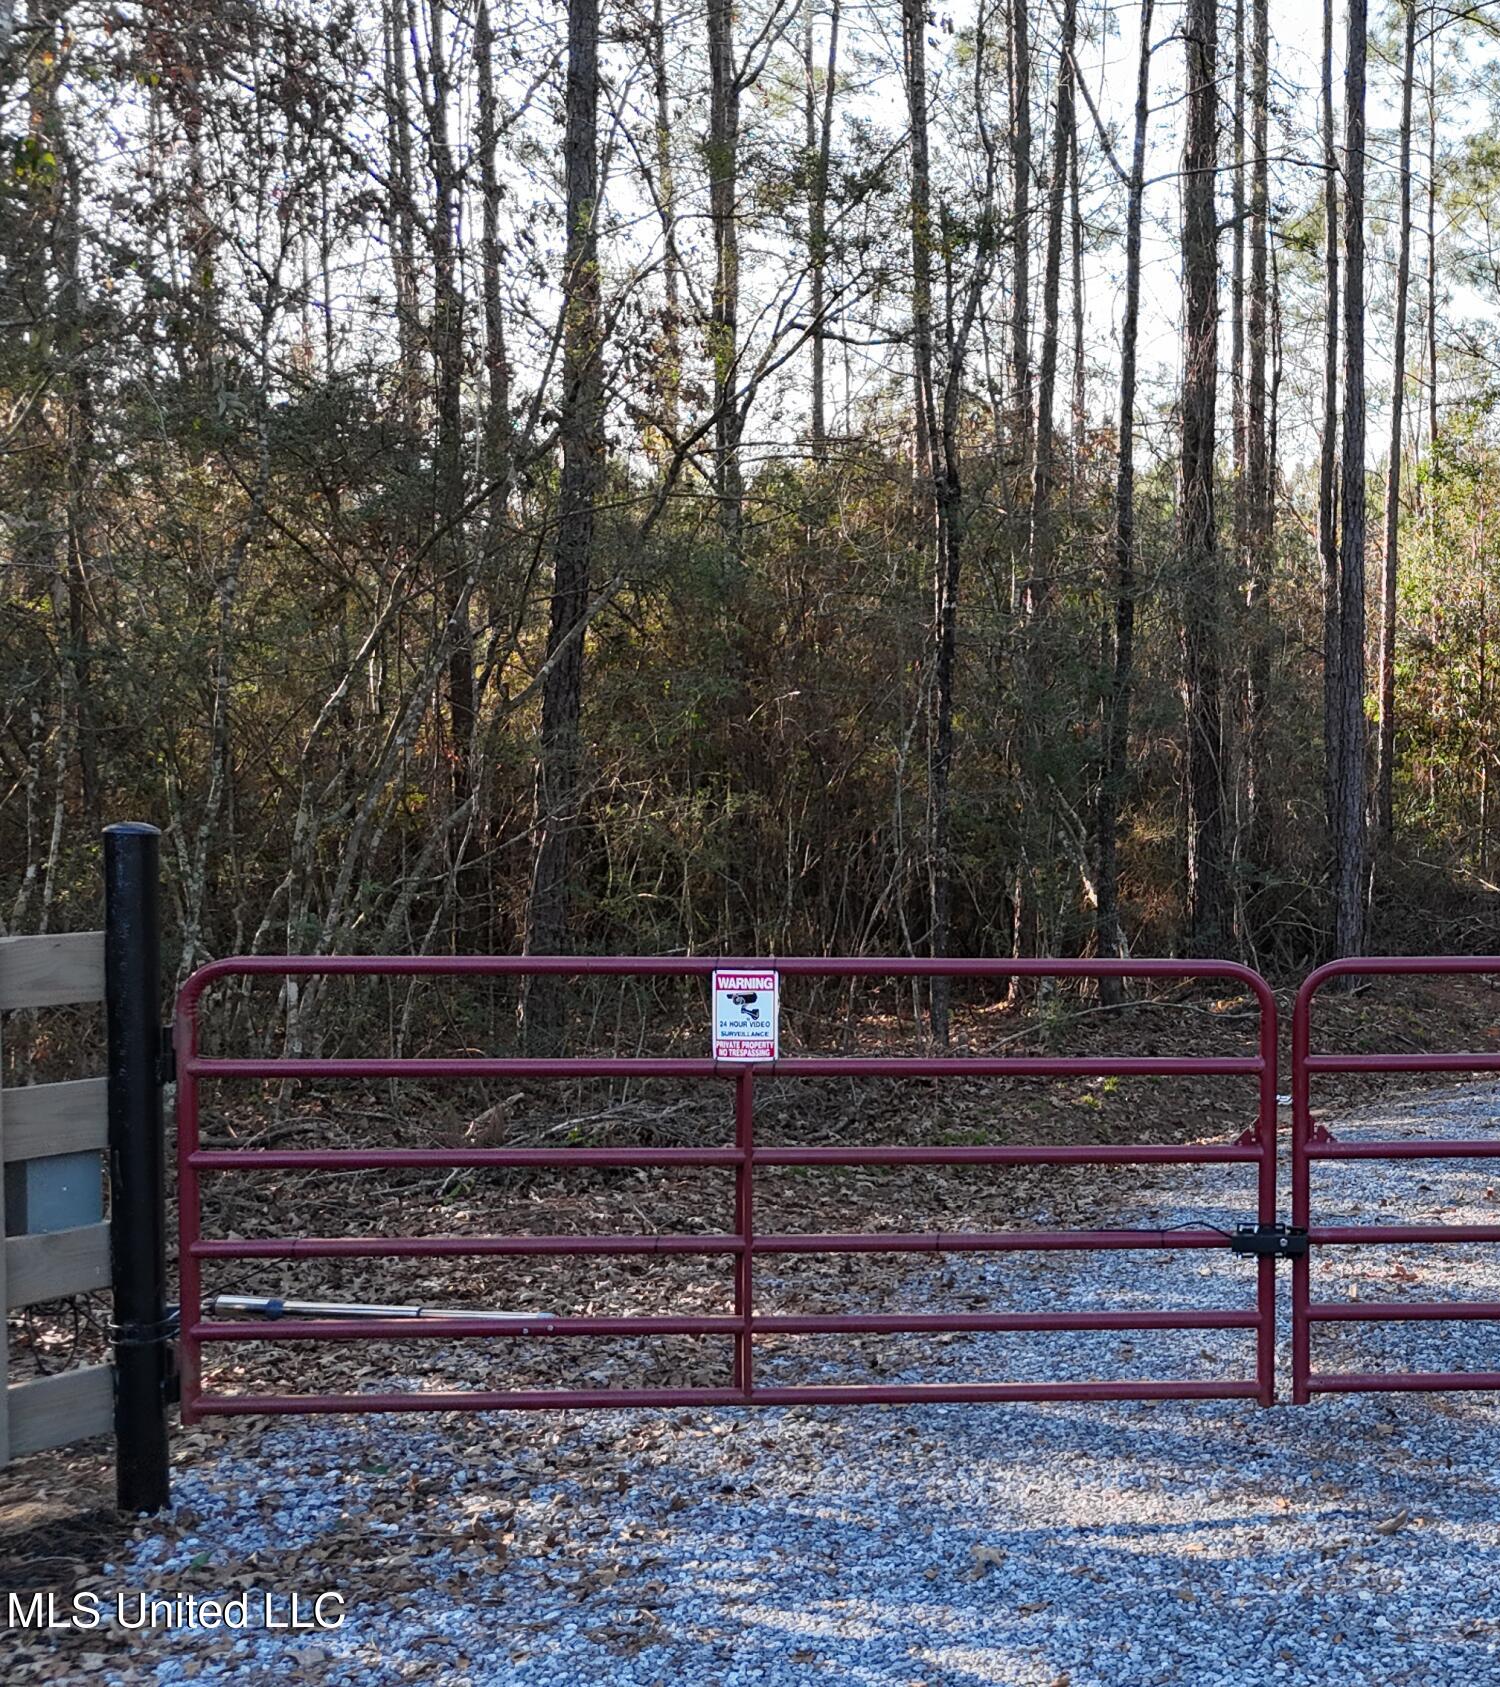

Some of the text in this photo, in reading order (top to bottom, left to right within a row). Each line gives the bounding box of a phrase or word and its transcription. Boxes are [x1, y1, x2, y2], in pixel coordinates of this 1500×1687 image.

[717, 976, 774, 989] WARNING
[716, 1041, 774, 1049] PRIVATE PROPERTY
[729, 1049, 771, 1057] TRESPASSING
